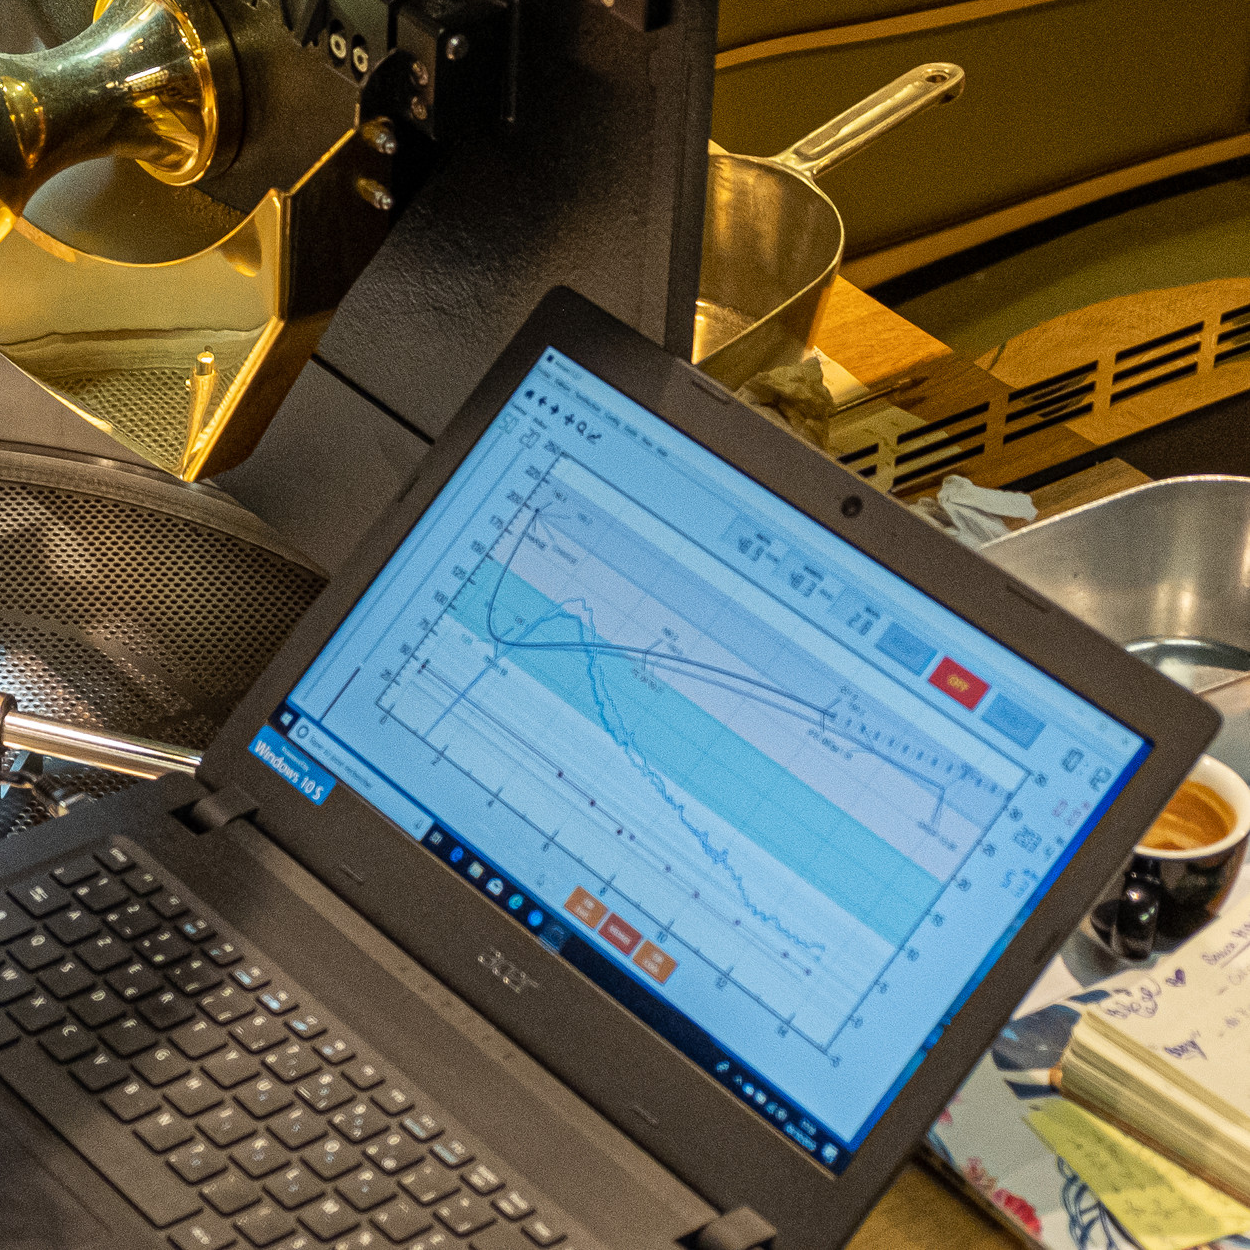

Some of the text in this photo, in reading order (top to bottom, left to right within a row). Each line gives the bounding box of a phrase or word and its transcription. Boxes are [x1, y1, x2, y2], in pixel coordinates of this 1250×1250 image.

[254, 740, 325, 801] Windows 10 S
[127, 905, 140, 913] 2
[69, 911, 80, 920] A
[97, 937, 111, 947] Z
[129, 964, 141, 973] E
[161, 993, 173, 1003] R
[227, 1052, 238, 1060] Y
[257, 1080, 272, 1091] U
[477, 947, 540, 994] acer
[3, 969, 17, 980] W
[32, 997, 45, 1007] X
[63, 1026, 77, 1036] C
[95, 1055, 107, 1064] V
[125, 1084, 139, 1094] B
[158, 1113, 172, 1126] N
[61, 963, 74, 972] S
[155, 1050, 170, 1060] G
